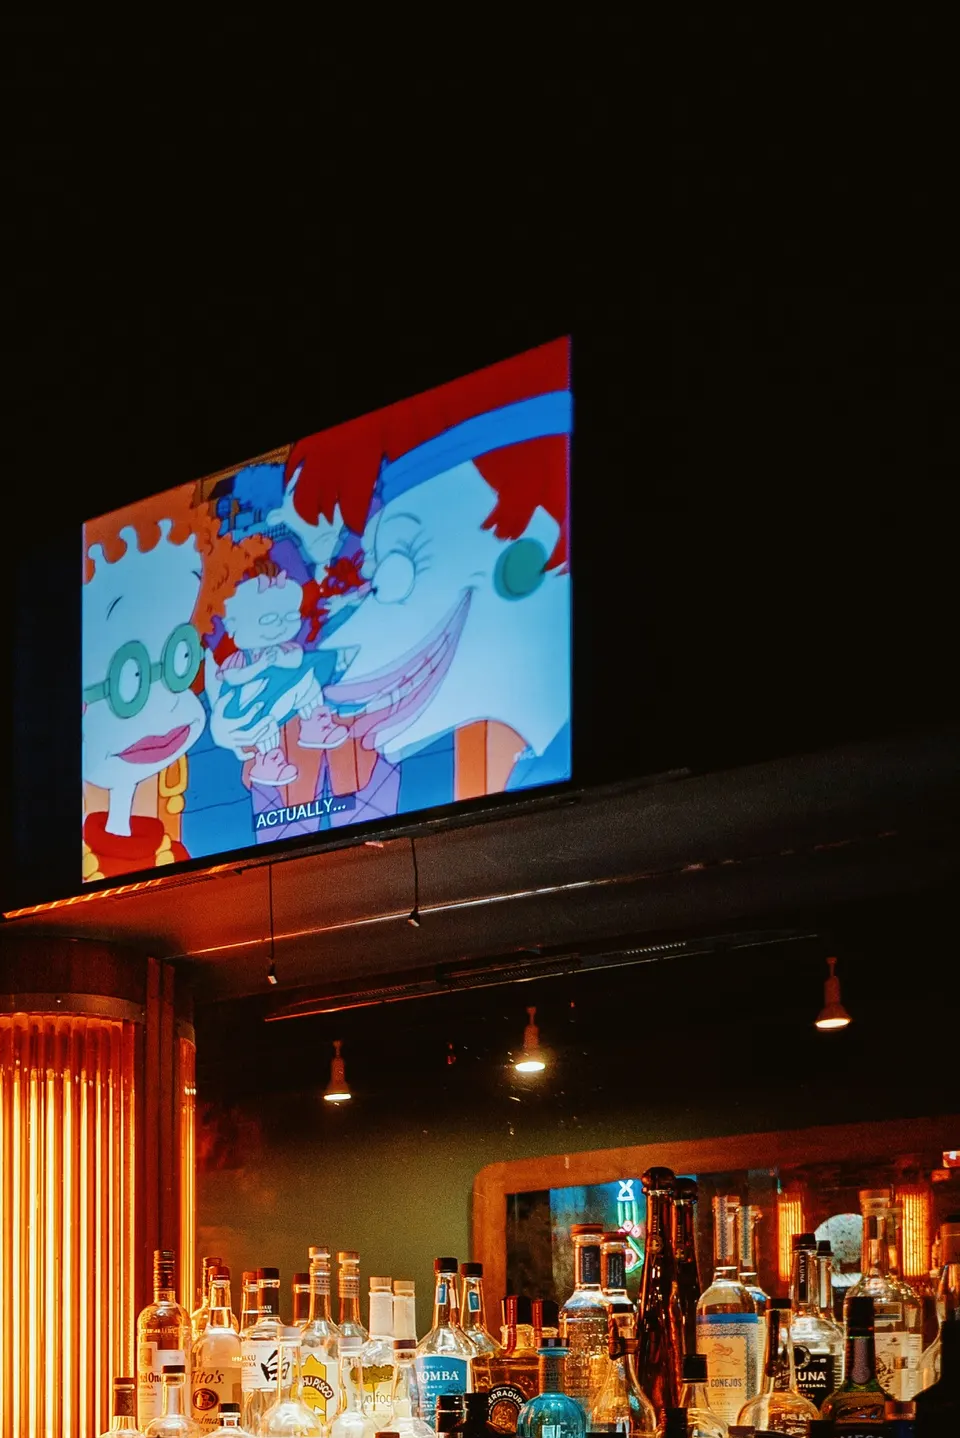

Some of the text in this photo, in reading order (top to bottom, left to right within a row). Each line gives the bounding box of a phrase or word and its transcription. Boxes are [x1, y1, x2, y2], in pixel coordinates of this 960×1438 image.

[256, 798, 346, 828] ACTUALLY...
[313, 1380, 333, 1399] PISCO
[711, 1378, 742, 1388] CONEJOS
[488, 1390, 526, 1409] ERRADURA
